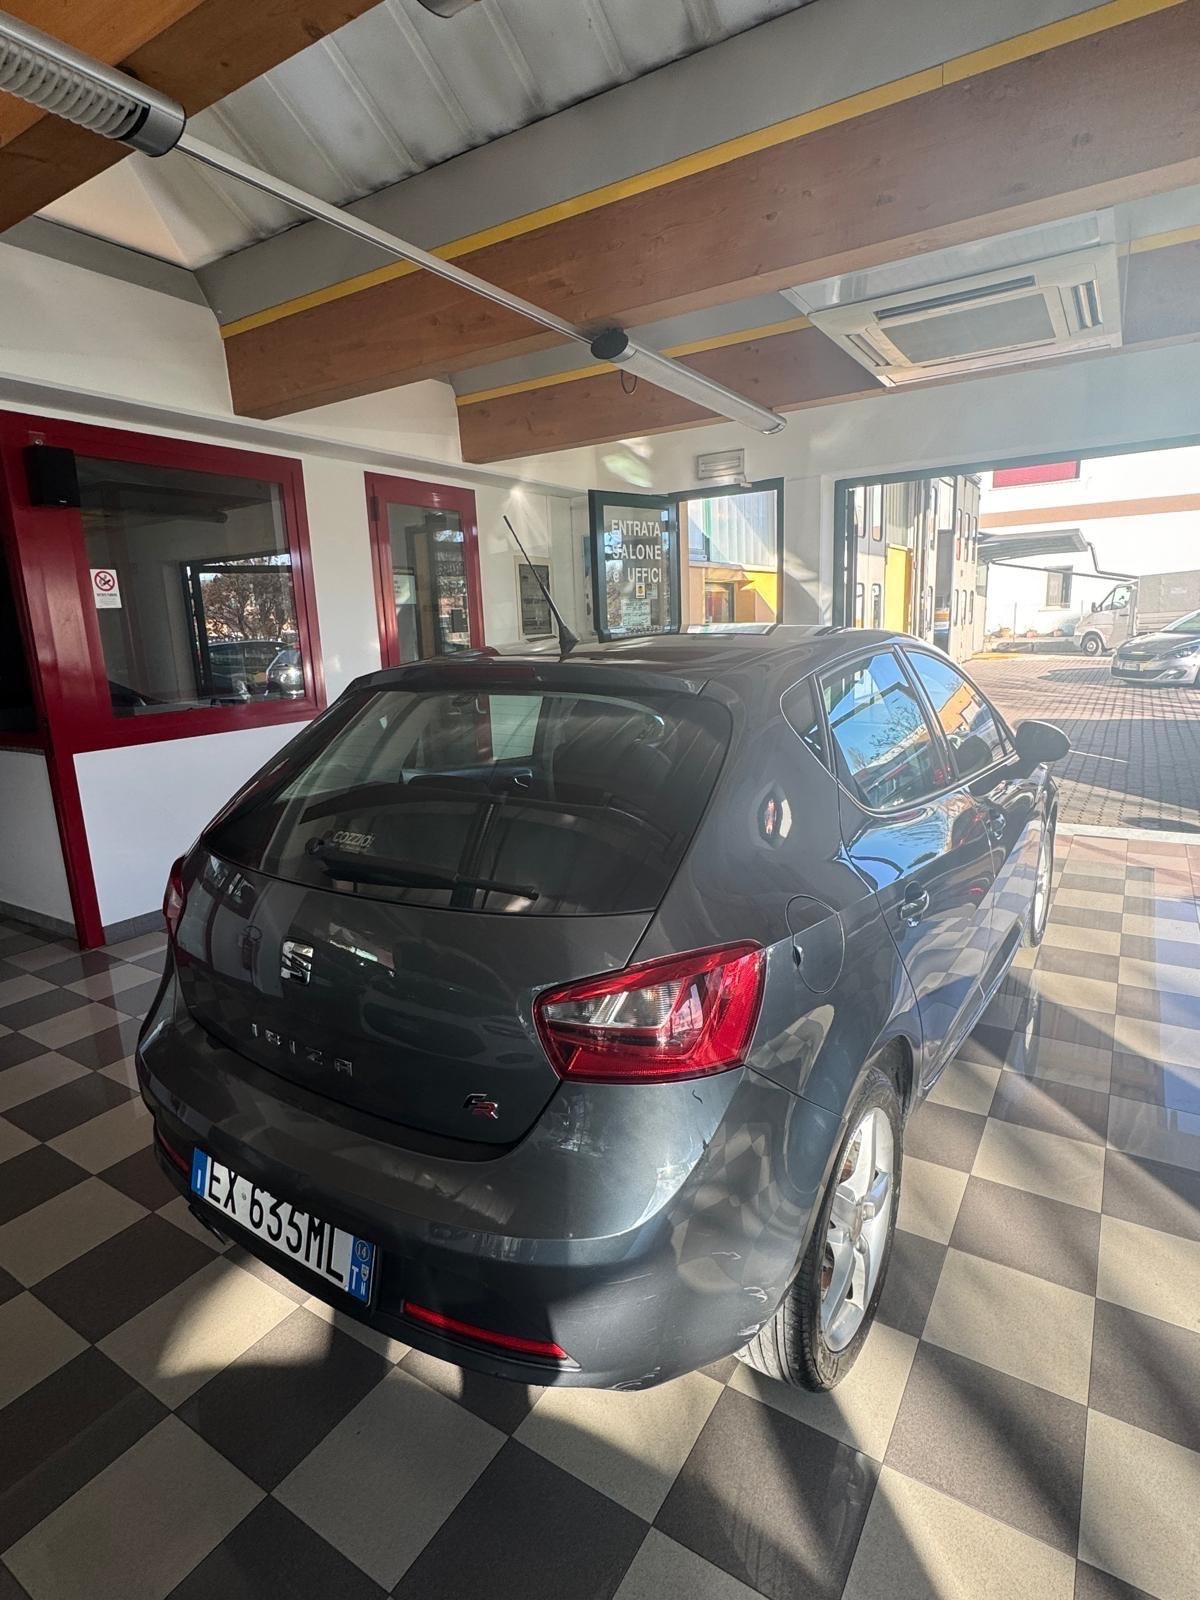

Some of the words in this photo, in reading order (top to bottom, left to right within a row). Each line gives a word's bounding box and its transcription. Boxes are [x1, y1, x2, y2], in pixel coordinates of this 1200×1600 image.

[611, 519, 661, 536] ENTRATA
[612, 544, 662, 560] SALONE
[613, 571, 620, 583] e
[627, 567, 662, 583] UFFICI
[463, 1093, 498, 1120] FR
[208, 1157, 240, 1215] EX
[249, 1186, 344, 1284] 635ML
